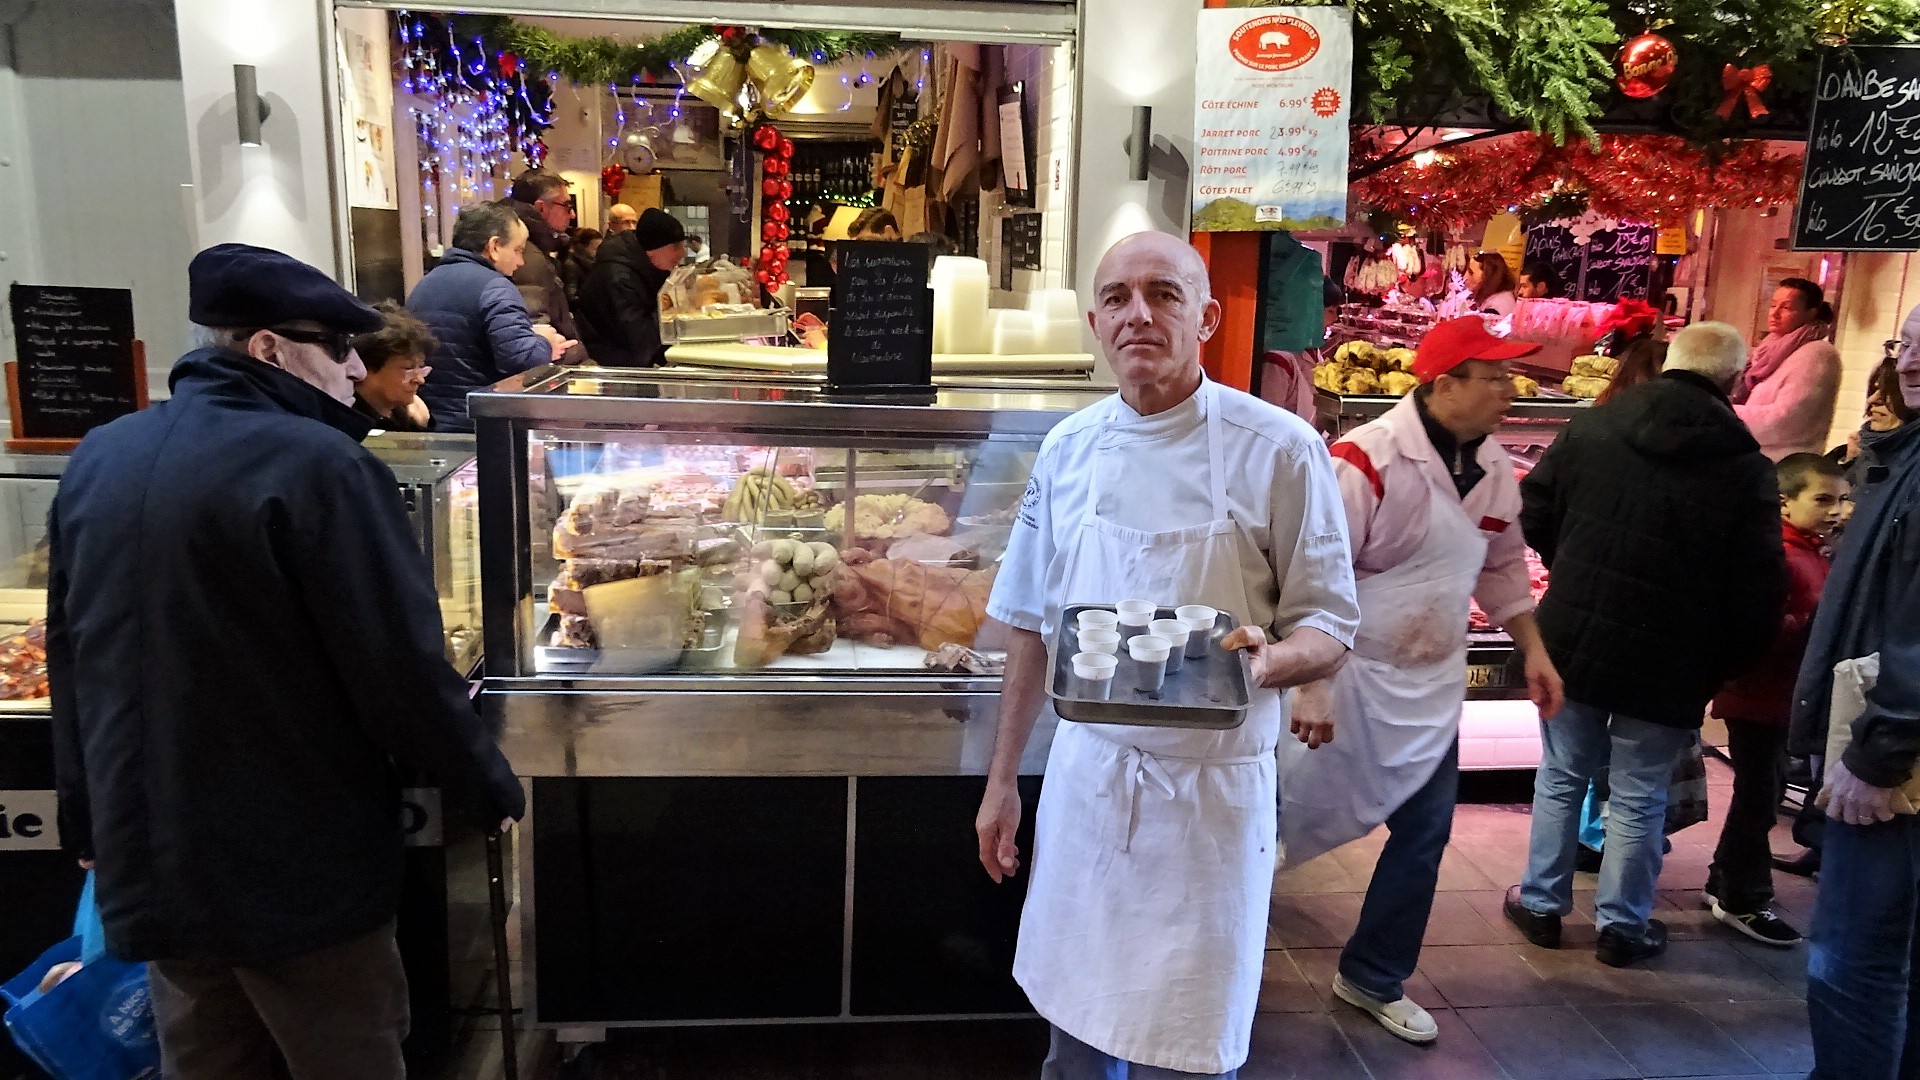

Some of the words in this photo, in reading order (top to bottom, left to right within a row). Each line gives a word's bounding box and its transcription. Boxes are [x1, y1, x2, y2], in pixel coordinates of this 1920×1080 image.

[1232, 17, 1271, 41] SOUTENONS
[1623, 59, 1662, 80] Bonne
[1226, 99, 1259, 109] ÉCHINE
[1201, 129, 1234, 138] JARRET
[1236, 129, 1261, 137] PORC
[1200, 147, 1242, 156] POITRINE
[1244, 148, 1268, 156] PORC
[1200, 165, 1221, 174] RÔTI
[1223, 166, 1247, 174] PORC
[1200, 185, 1226, 194] CÔTES
[1229, 186, 1252, 194] FILET
